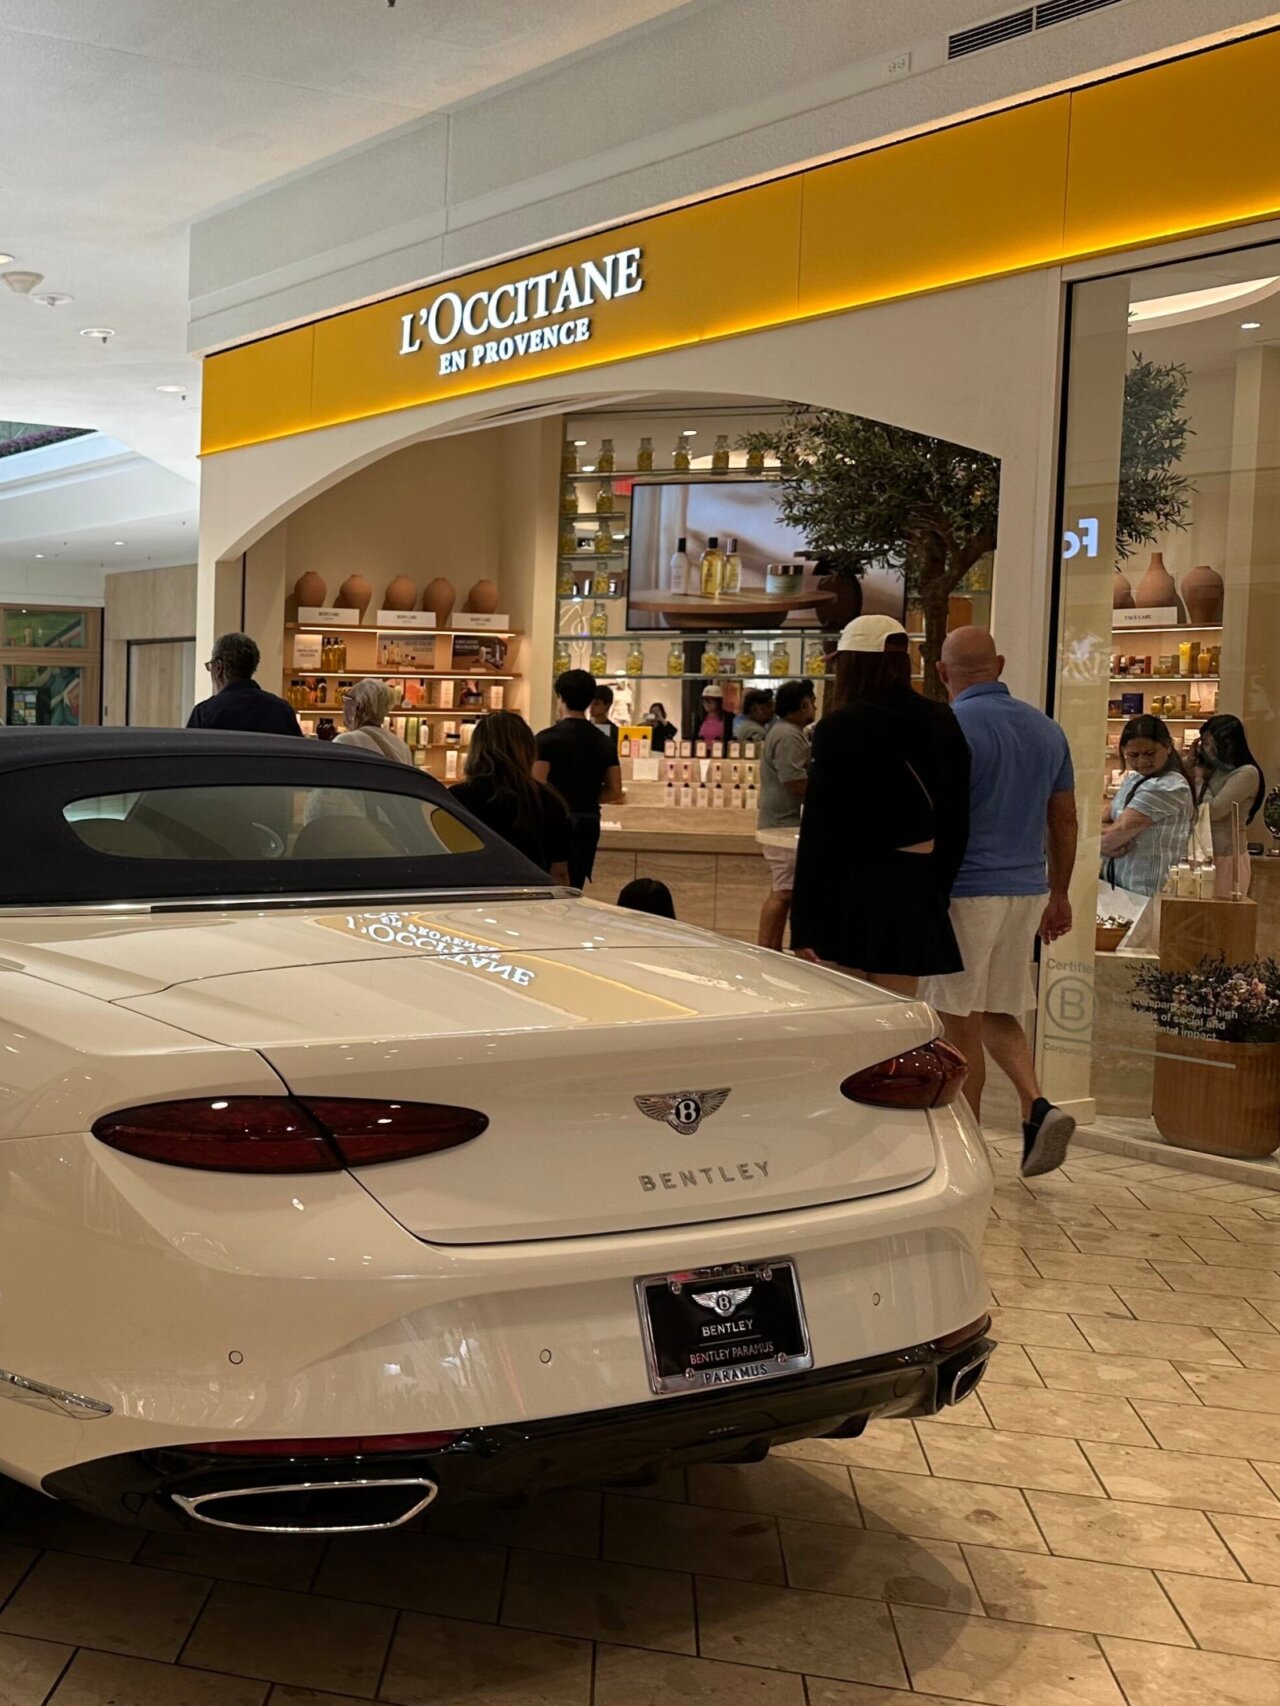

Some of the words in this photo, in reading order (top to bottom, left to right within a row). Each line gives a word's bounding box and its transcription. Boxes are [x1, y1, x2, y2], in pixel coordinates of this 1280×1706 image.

[399, 247, 643, 355] L'OCCITANE
[438, 348, 466, 375] EN
[472, 317, 590, 368] PROVENCE
[1160, 1013, 1171, 1022] of
[1173, 1015, 1204, 1026] social
[1206, 1019, 1226, 1030] and
[1215, 1007, 1238, 1020] high
[638, 1160, 769, 1192] BENTLEY
[702, 1319, 753, 1337] BENTLEY
[689, 1348, 730, 1365] BENTLEY
[732, 1341, 774, 1358] PARAMUS
[703, 1363, 768, 1384] PARAMUS
